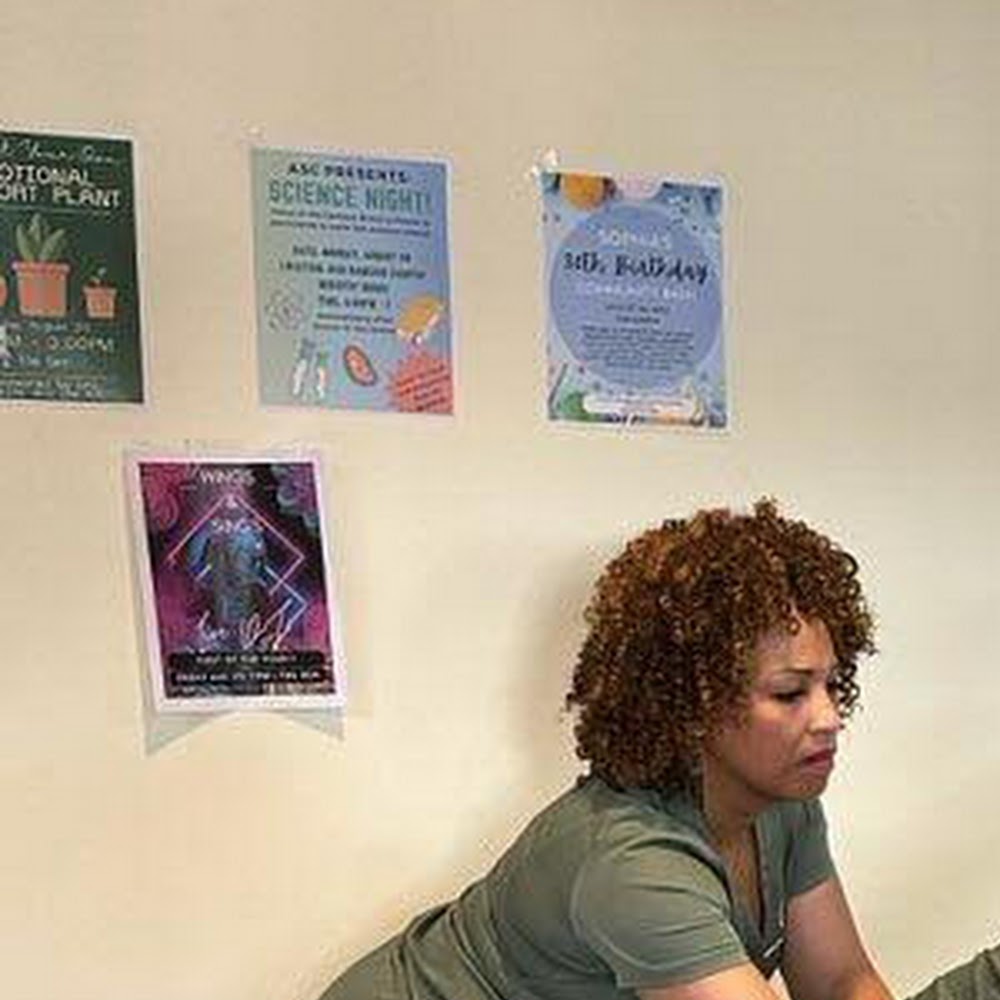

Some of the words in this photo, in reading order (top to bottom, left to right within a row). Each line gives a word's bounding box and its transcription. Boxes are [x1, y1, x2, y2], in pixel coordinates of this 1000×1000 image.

[53, 187, 120, 208] PLANT
[269, 180, 359, 208] SCIENCE
[365, 186, 431, 216] NIGHT!
[615, 254, 708, 285] Birthday
